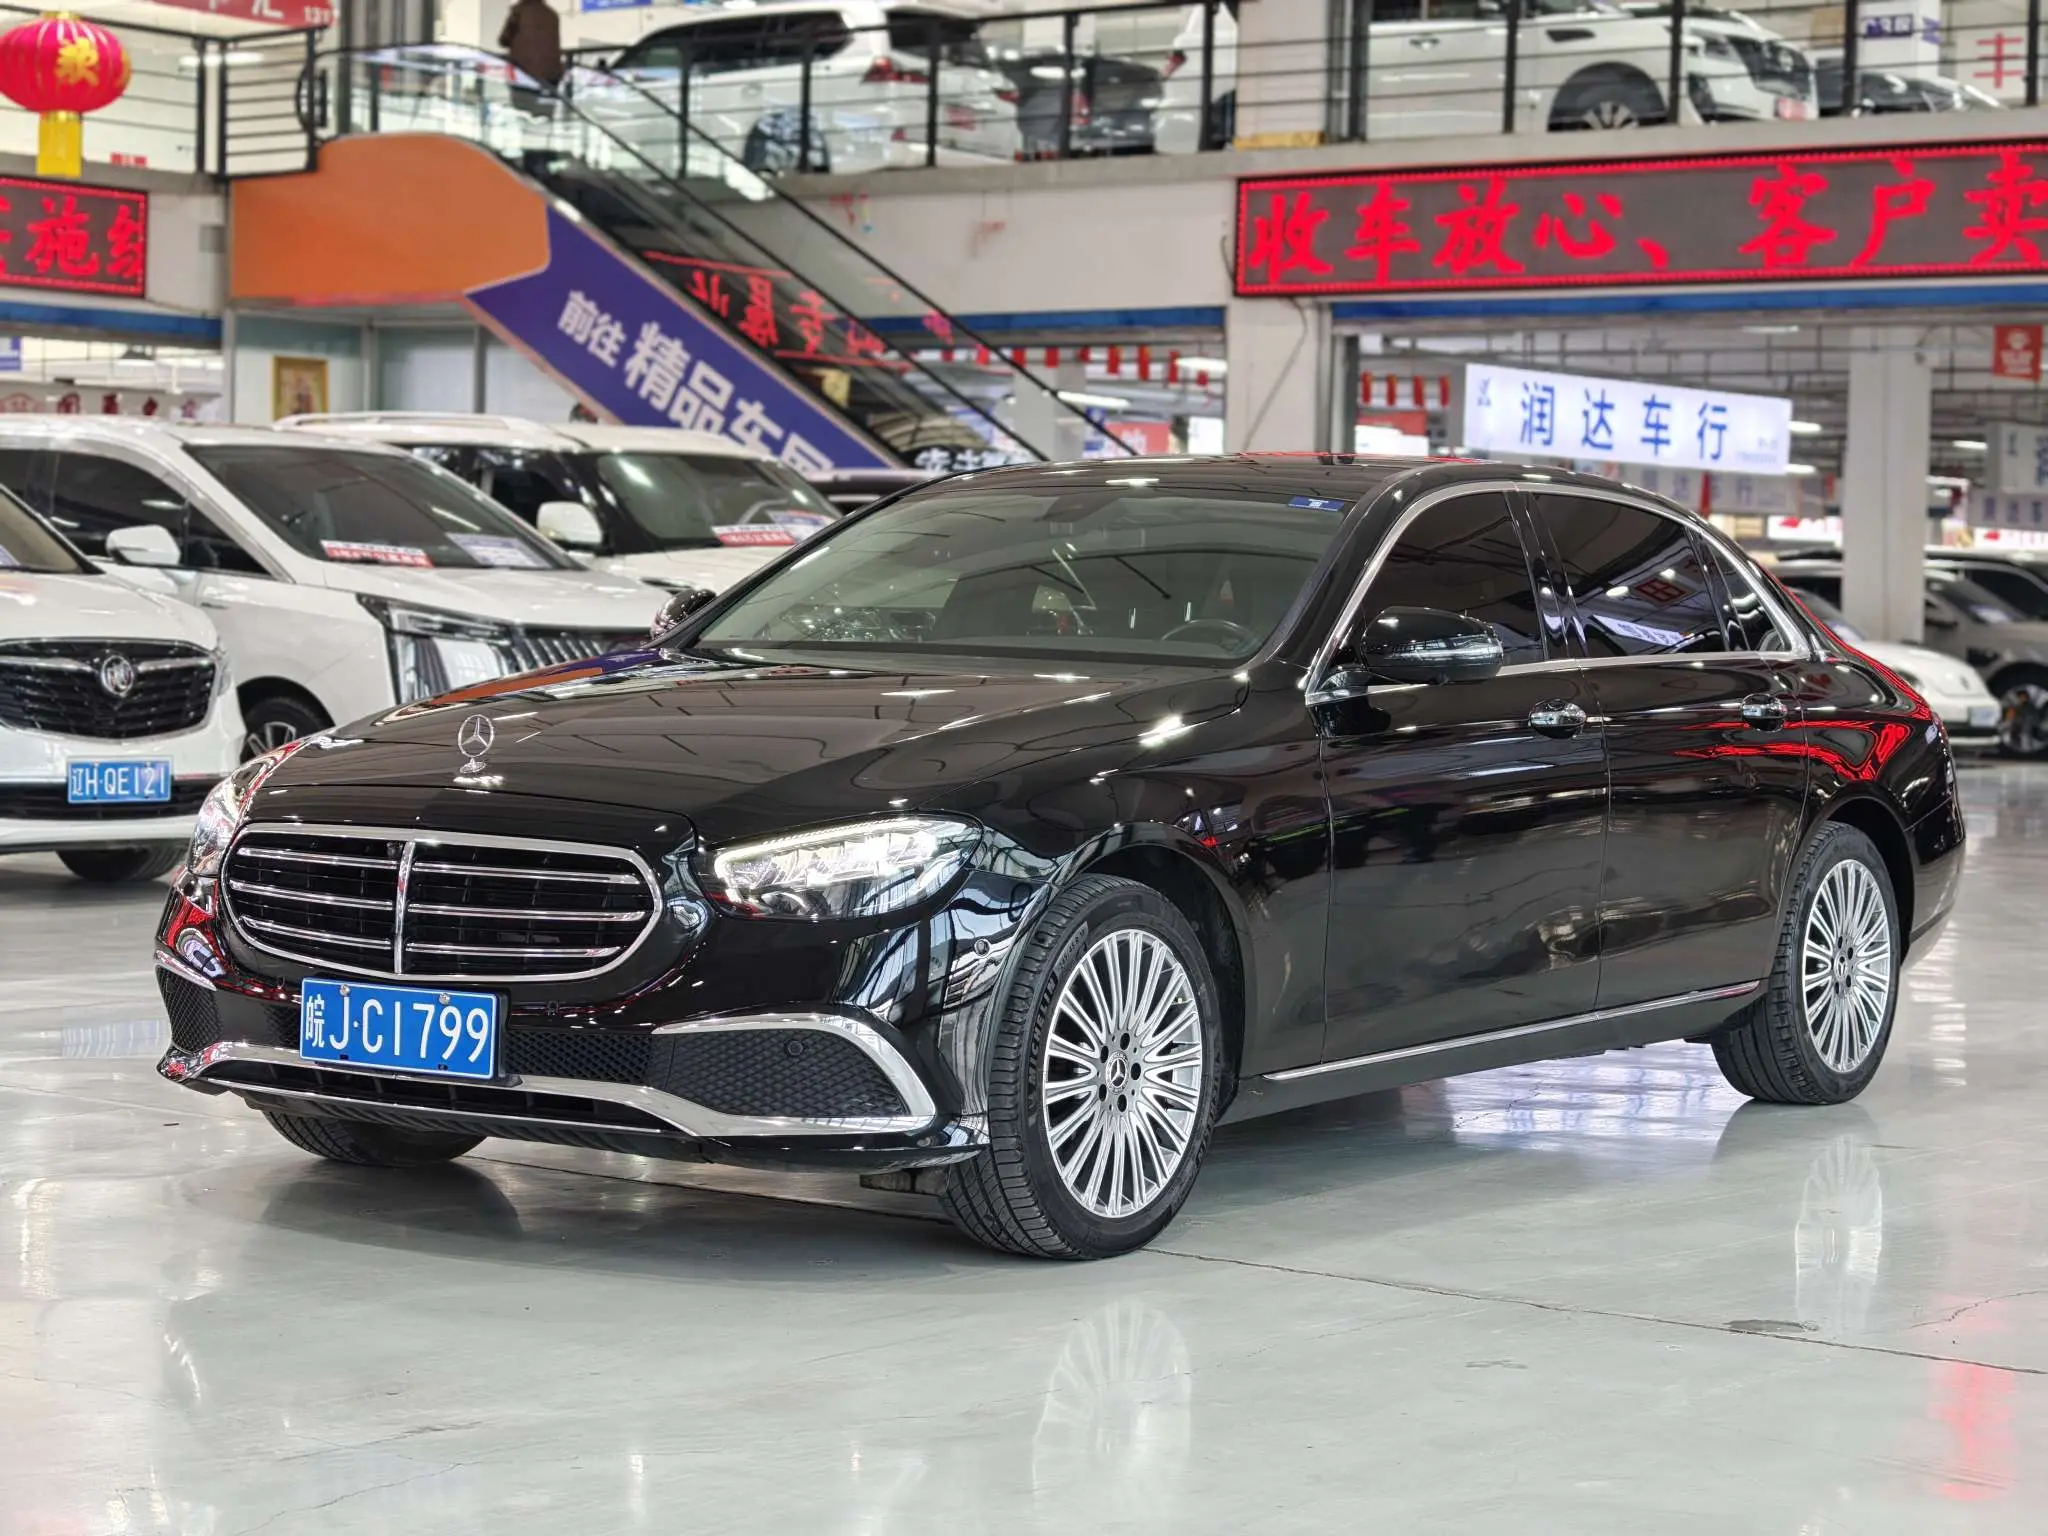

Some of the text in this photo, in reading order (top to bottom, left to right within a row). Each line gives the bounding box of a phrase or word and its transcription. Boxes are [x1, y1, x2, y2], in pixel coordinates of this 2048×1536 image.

[1520, 381, 1728, 461] 润达车行
[305, 994, 489, 1063] 皖J·C1799
[1028, 971, 1058, 1085] MICHELIN
